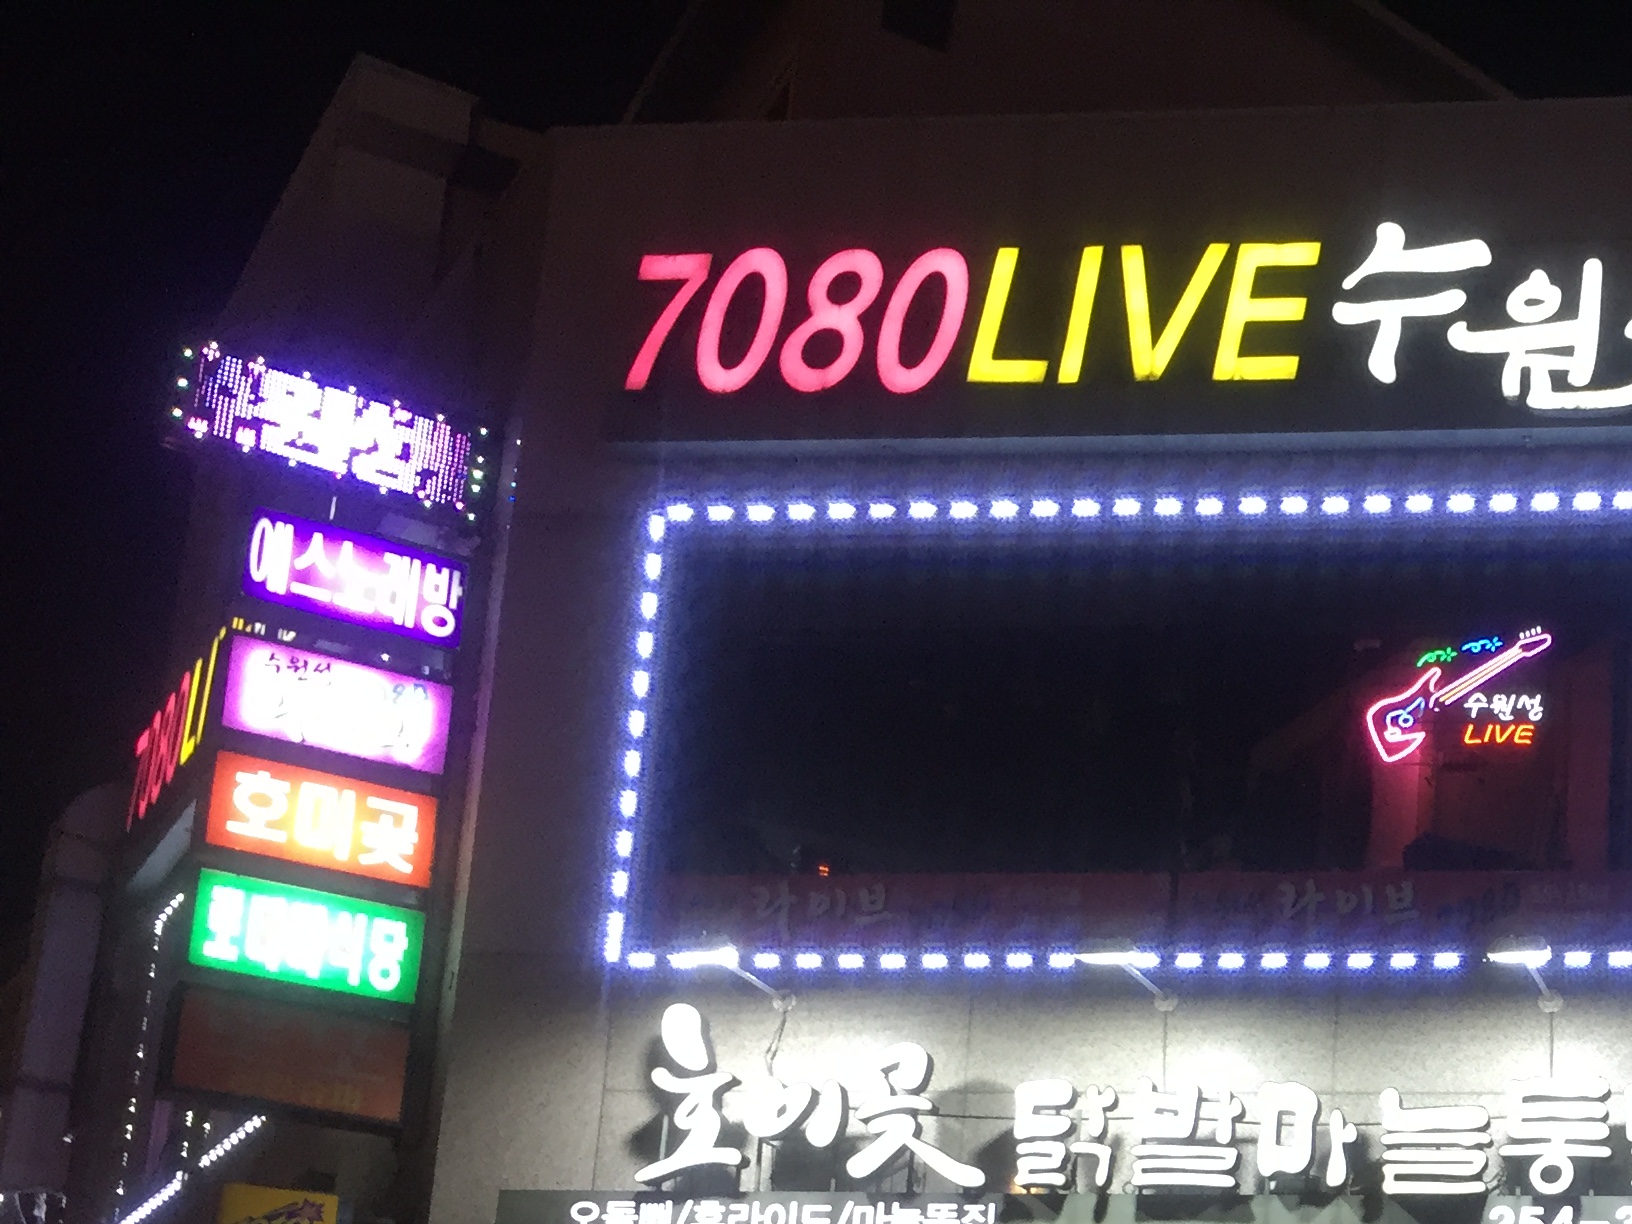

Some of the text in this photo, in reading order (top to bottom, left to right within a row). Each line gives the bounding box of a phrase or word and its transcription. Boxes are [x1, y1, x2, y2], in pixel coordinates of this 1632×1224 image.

[1463, 724, 1535, 744] LIVE
[1464, 692, 1544, 721] 수원성
[225, 769, 421, 874] 호미곶
[635, 1003, 986, 1187] 호미곶
